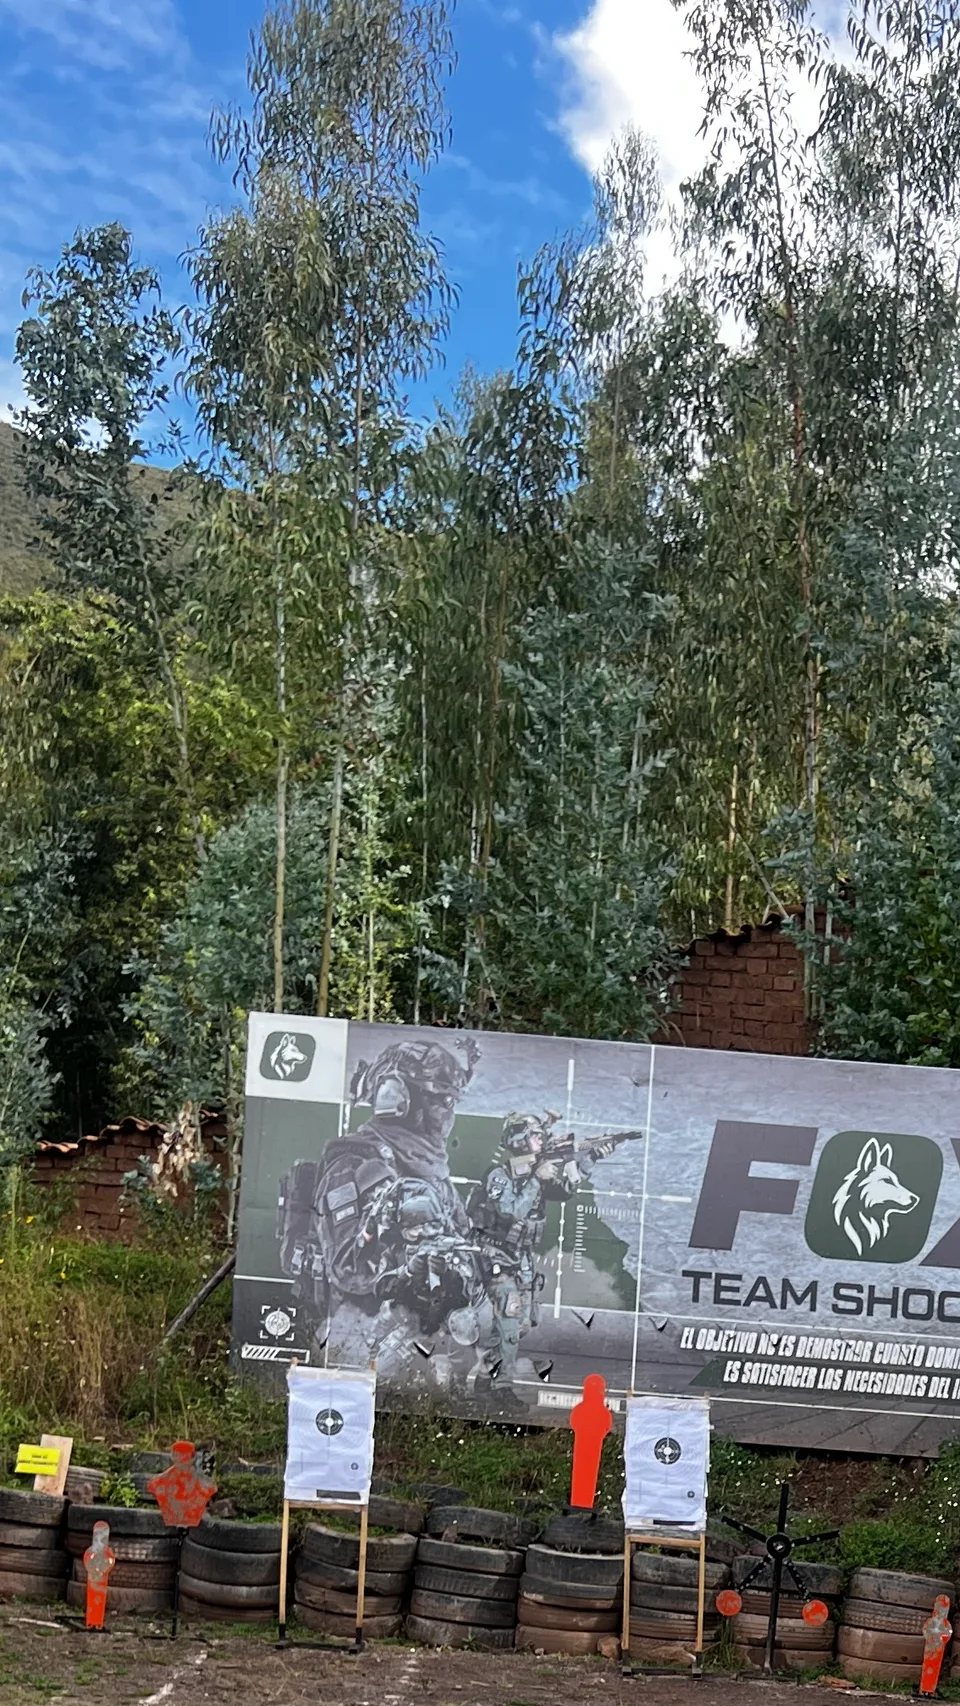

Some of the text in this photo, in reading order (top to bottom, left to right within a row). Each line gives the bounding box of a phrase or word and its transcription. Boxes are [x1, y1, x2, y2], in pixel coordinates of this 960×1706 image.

[682, 1270, 818, 1313] TEAM
[680, 1327, 696, 1349] EL
[696, 1328, 758, 1355] OBJETIVO
[777, 1334, 796, 1358] ES
[796, 1336, 874, 1363] DEMOSTRAR
[723, 1360, 741, 1384] ES
[741, 1362, 818, 1389] SATISFACER
[817, 1368, 843, 1391] LAS
[843, 1370, 928, 1397] NECESIDADES
[928, 1376, 951, 1399] DEL
